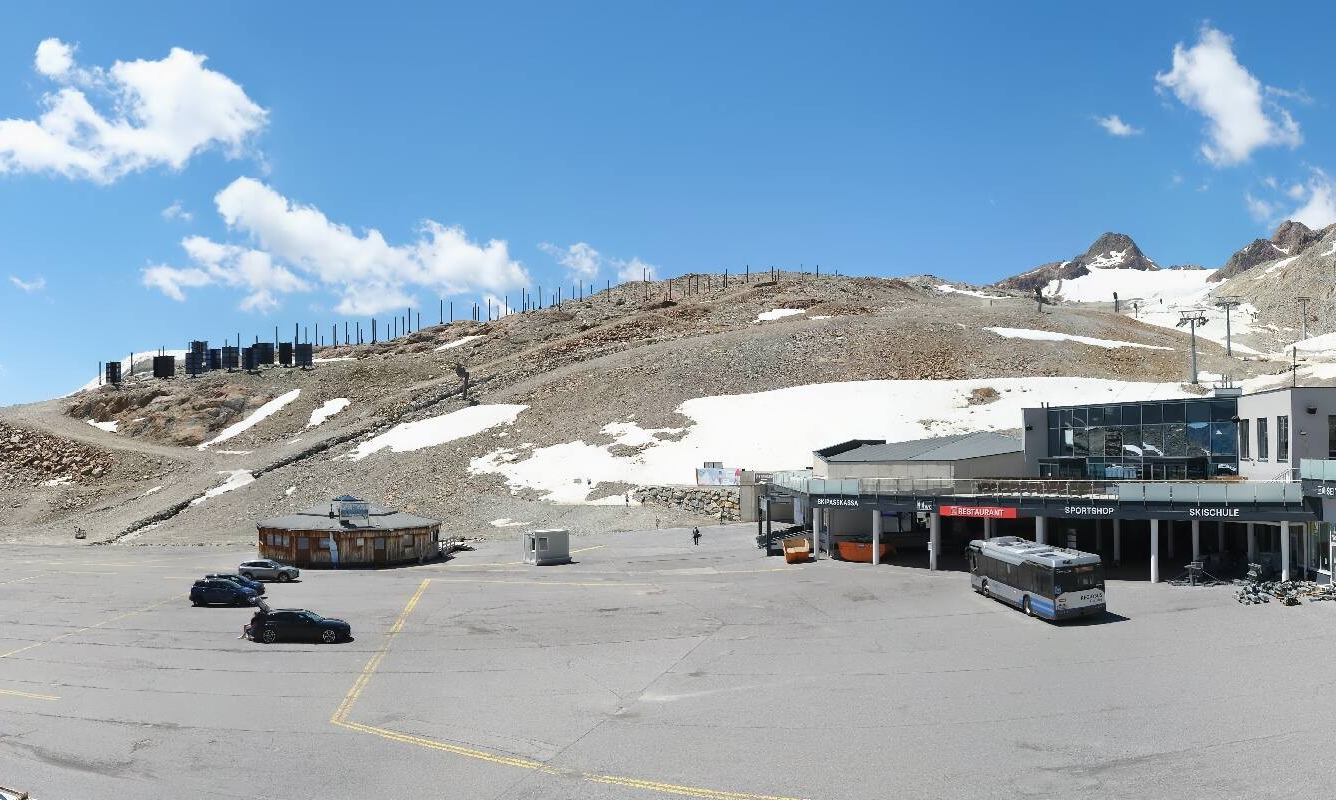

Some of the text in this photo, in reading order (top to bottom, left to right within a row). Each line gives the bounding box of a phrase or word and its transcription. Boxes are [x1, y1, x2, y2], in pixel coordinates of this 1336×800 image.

[958, 507, 1005, 517] RESTAURANT
[1064, 506, 1114, 515] SPORTSHOP
[1189, 508, 1240, 517] SKISCHULE
